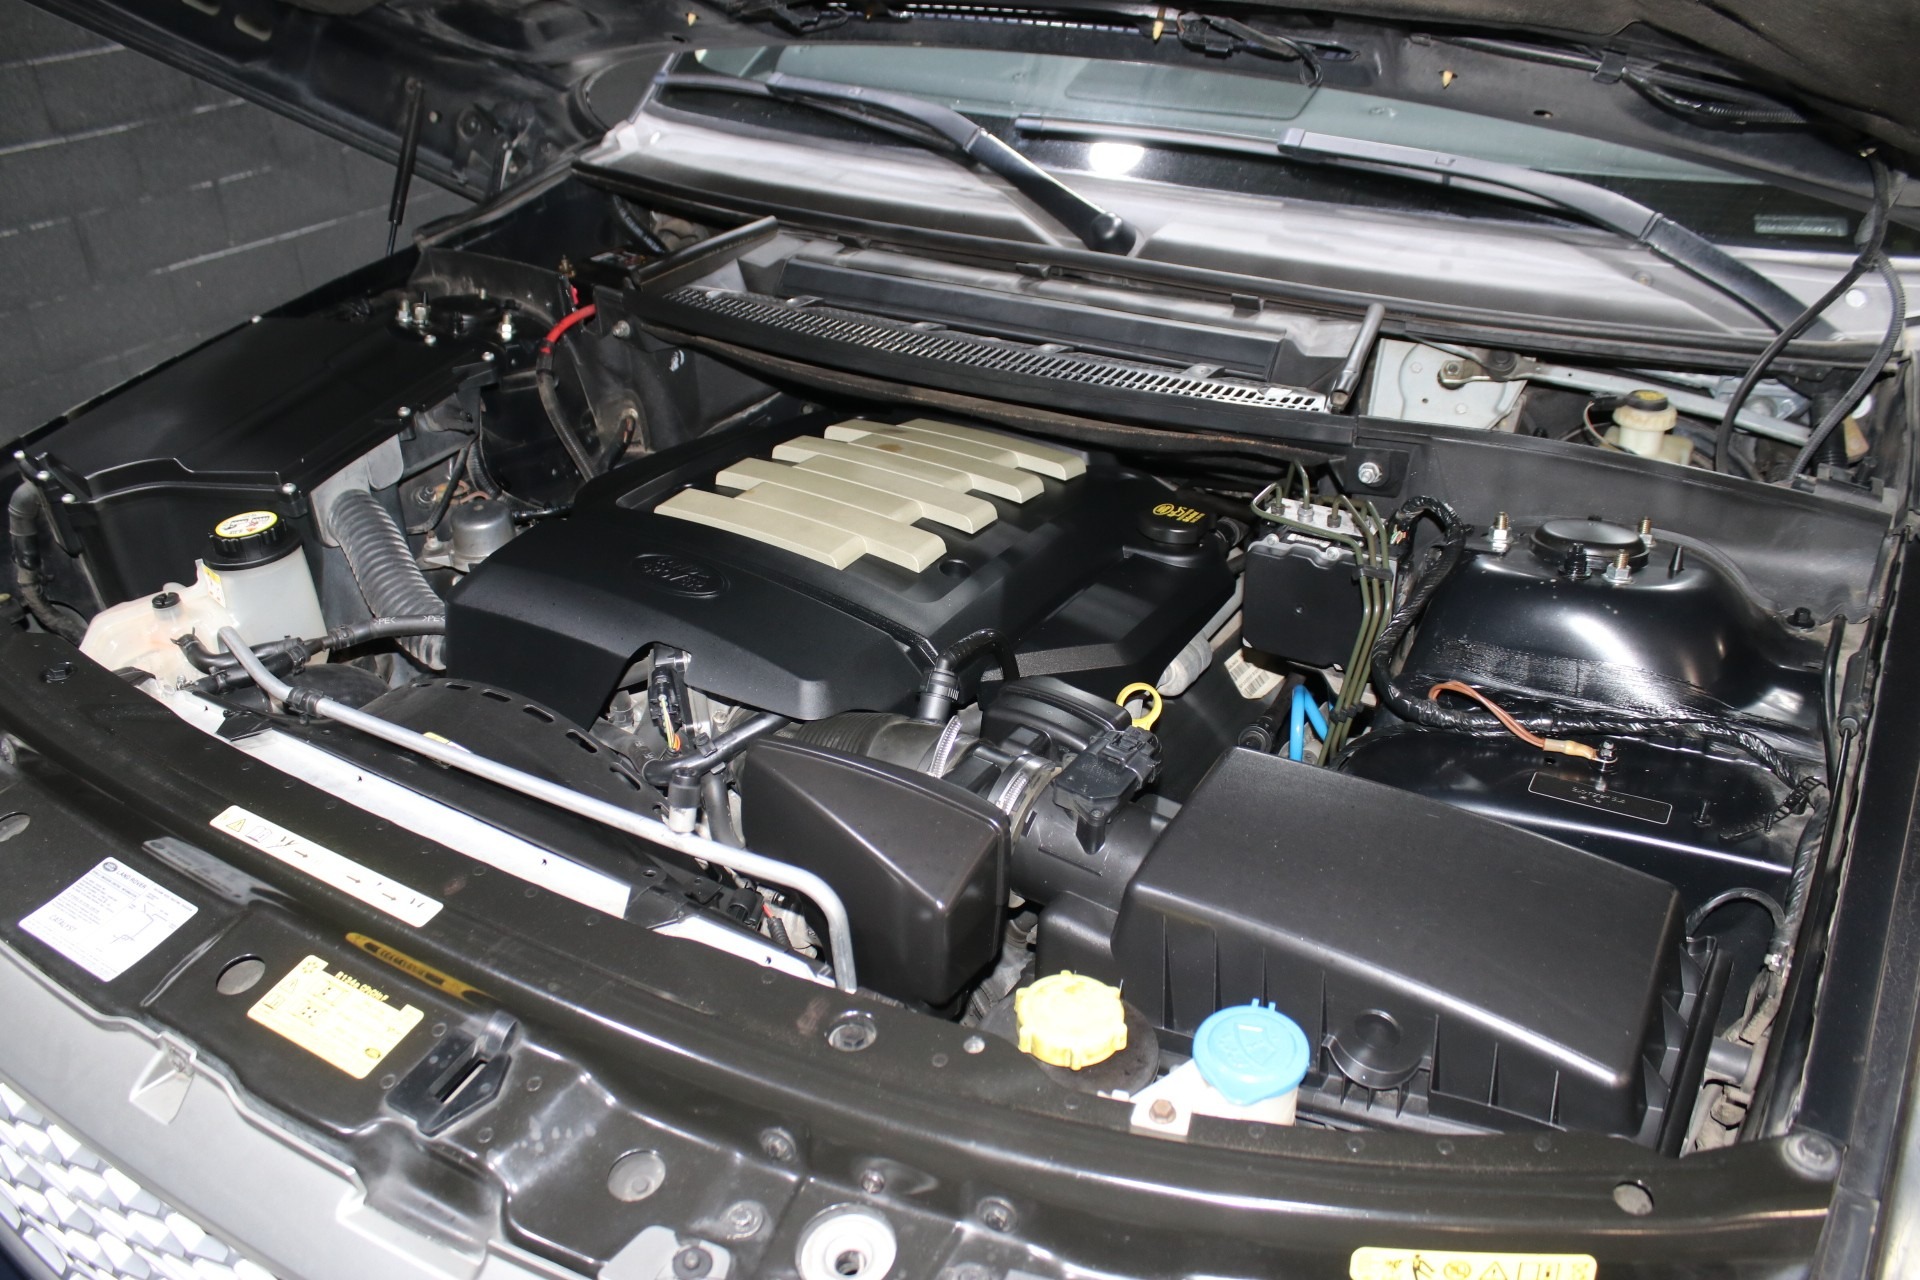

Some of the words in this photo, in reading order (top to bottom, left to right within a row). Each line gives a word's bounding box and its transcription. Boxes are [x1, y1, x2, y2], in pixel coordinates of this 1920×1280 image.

[116, 870, 131, 880] LAND
[130, 877, 147, 889] ROVER
[49, 914, 78, 932] CATALYST
